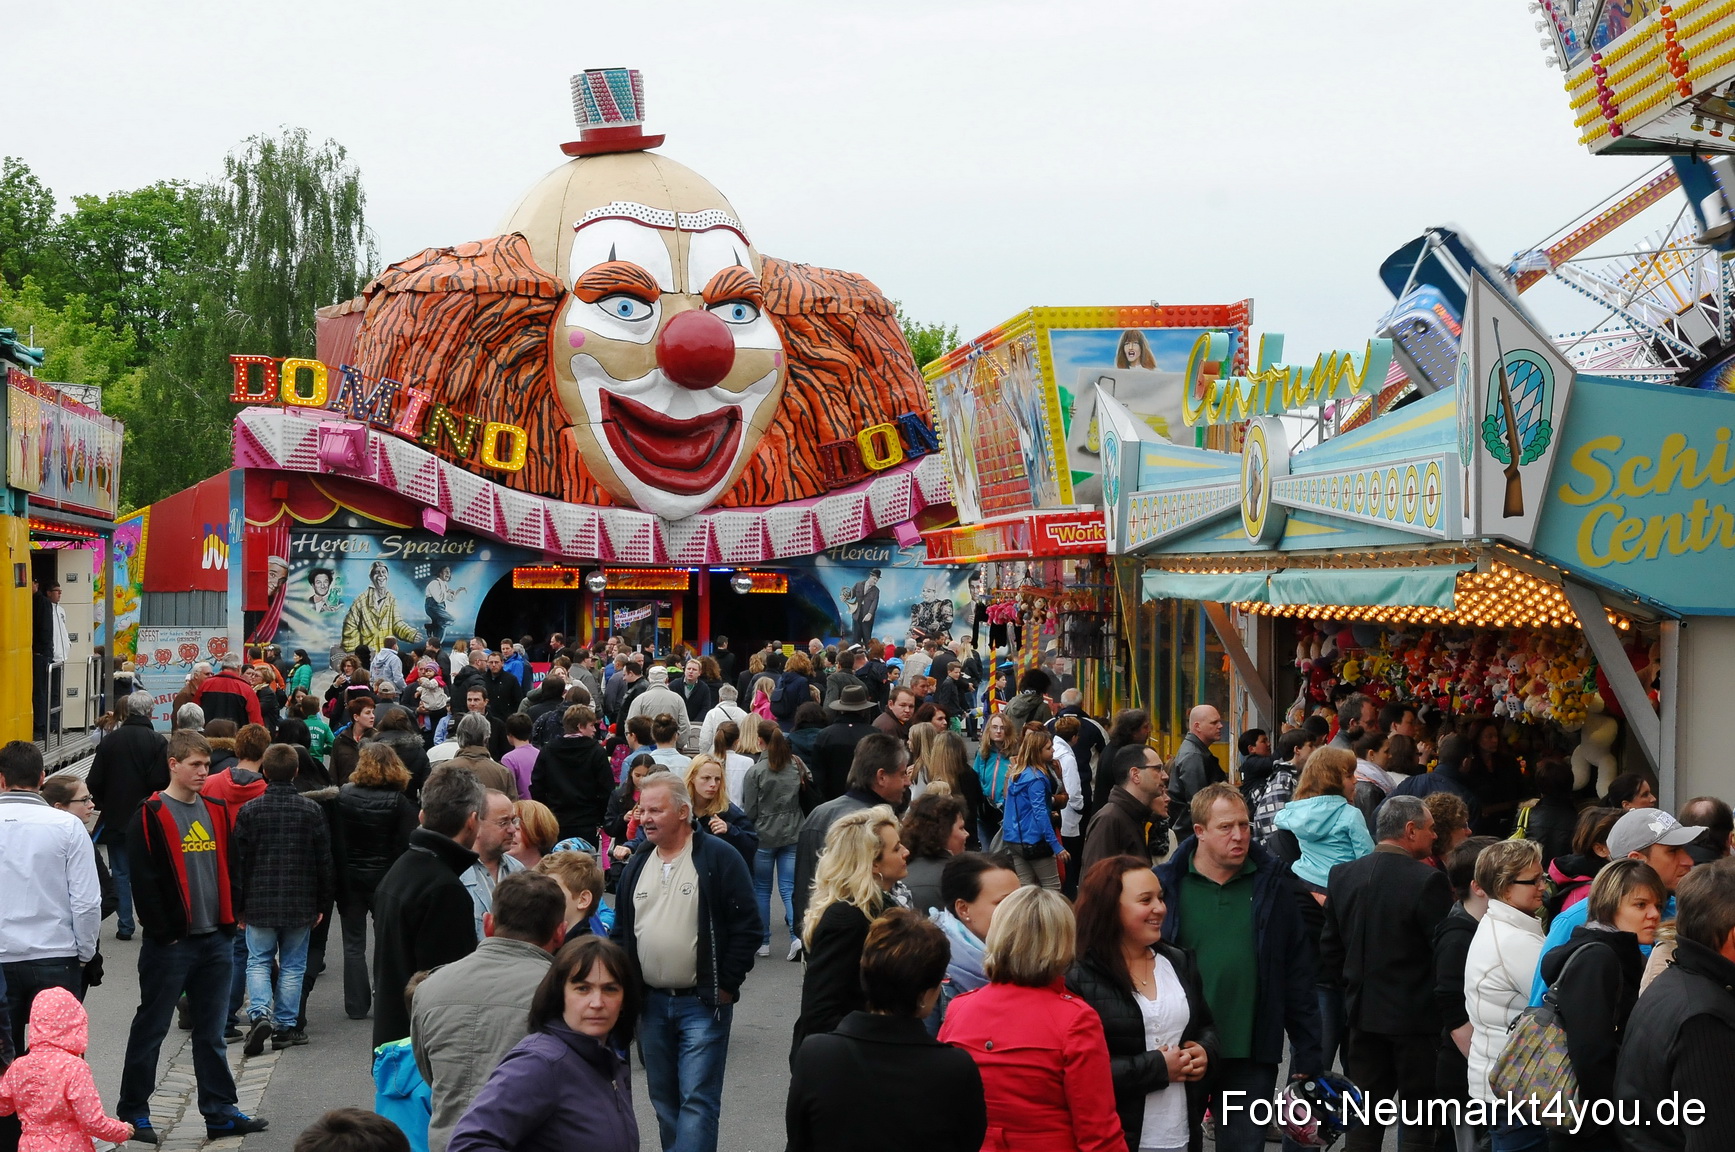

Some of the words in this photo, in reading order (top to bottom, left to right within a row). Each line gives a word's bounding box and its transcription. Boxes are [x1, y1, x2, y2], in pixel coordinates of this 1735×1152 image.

[1182, 332, 1386, 428] Centrum
[229, 354, 528, 472] DOMINO
[1558, 427, 1735, 506] Schi
[202, 523, 229, 571] DO
[292, 533, 371, 554] Herein
[376, 535, 476, 560] Spaziert
[181, 840, 216, 853] addas
